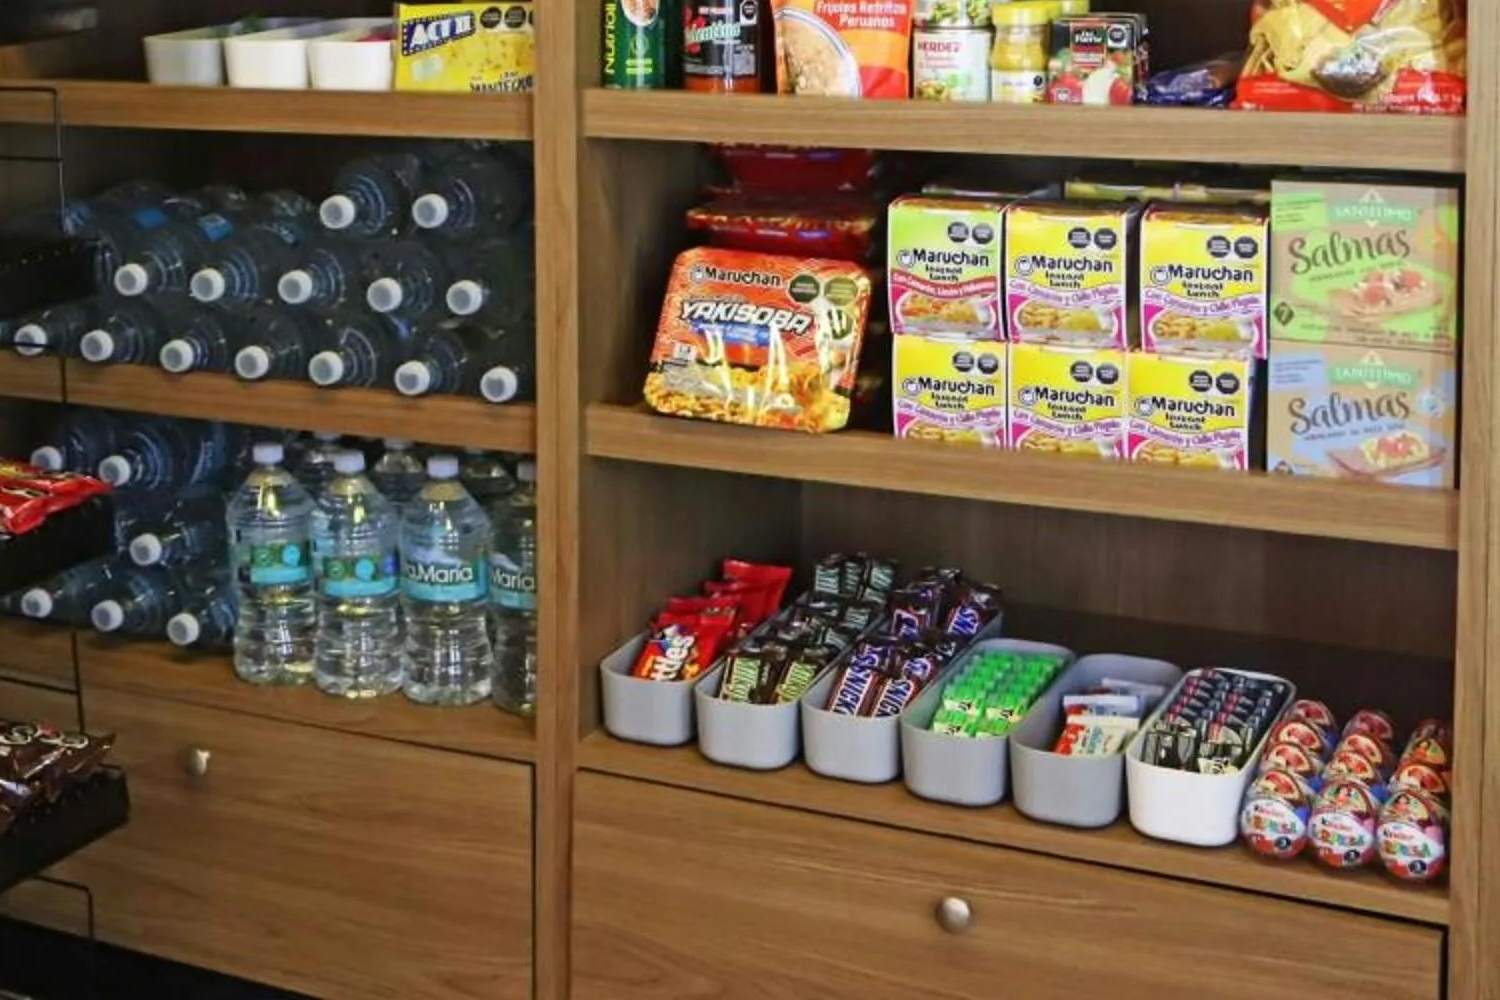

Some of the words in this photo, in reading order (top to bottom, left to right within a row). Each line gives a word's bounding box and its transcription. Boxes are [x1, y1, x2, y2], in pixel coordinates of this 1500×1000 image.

[839, 13, 895, 28] Peruanos
[913, 248, 990, 267] Maruchan
[1288, 228, 1411, 276] Salmas
[1031, 254, 1114, 273] Maruchan
[1167, 263, 1254, 283] Maruchan
[705, 265, 781, 288] Maruchan
[681, 301, 813, 335] YAKISOBA
[918, 377, 995, 397] Maruchan
[1034, 386, 1115, 407] Maruchan
[1151, 396, 1235, 417] Maruchan
[1288, 391, 1411, 436] Salmas
